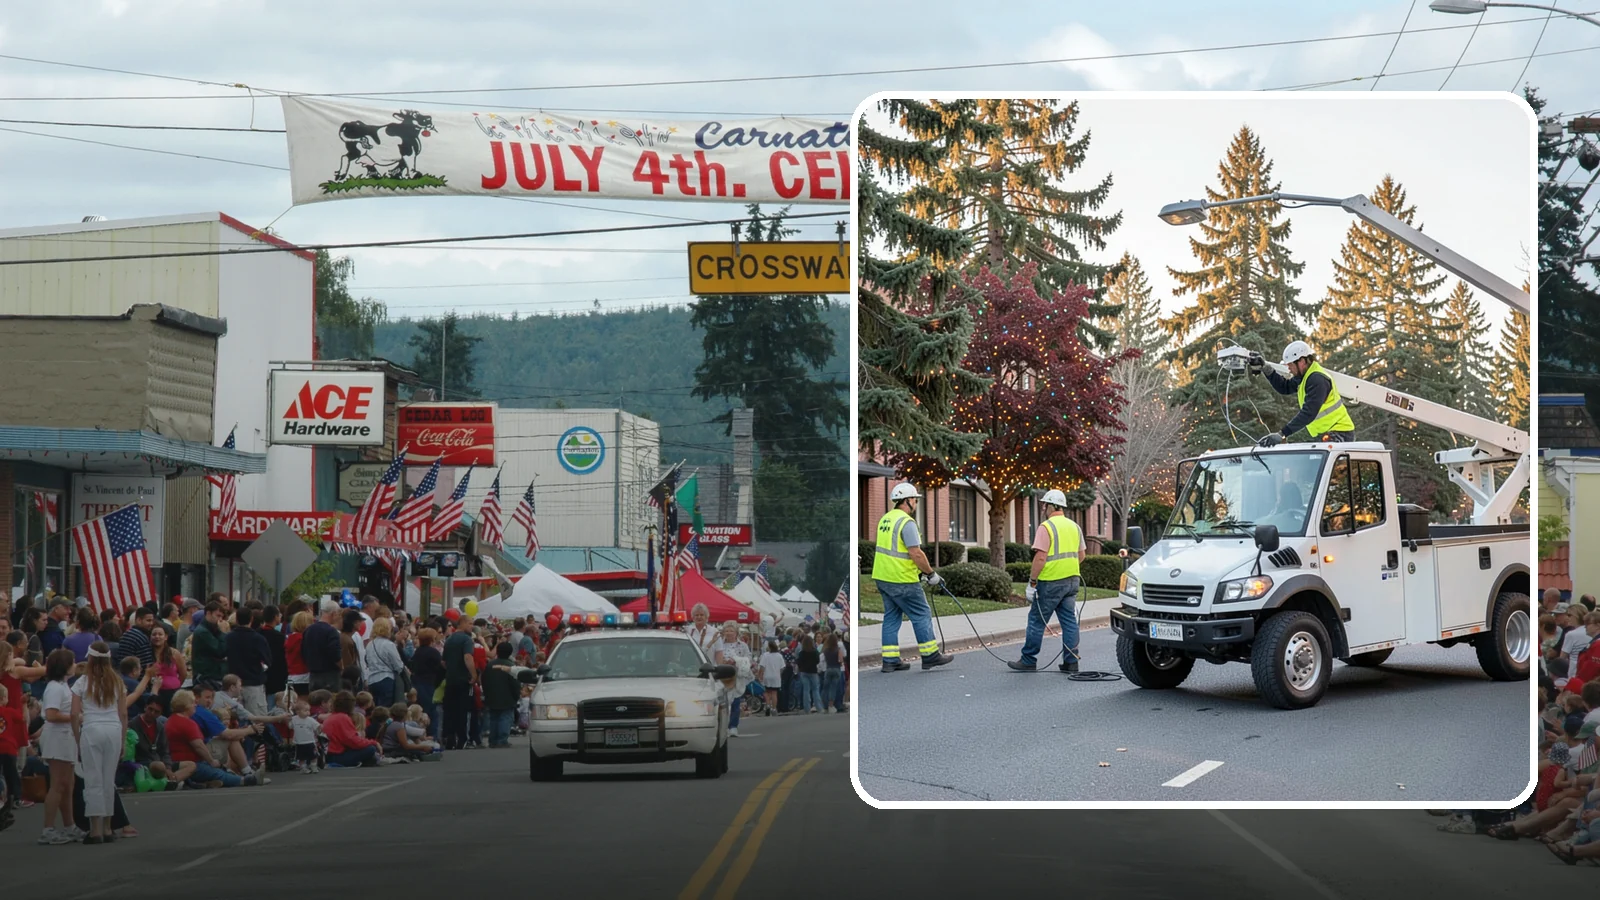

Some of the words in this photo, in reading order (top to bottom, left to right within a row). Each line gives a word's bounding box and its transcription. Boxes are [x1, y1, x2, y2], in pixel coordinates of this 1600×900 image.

[481, 140, 605, 192] JULY
[632, 150, 747, 198] 4th.
[697, 254, 850, 280] CROSSWA
[282, 380, 373, 420] ACE
[405, 409, 453, 422] CEDAR
[283, 421, 371, 436] Hardware
[416, 428, 477, 447] Coca-Cola
[353, 467, 383, 479] Simpl
[95, 485, 124, 495] Vincent
[126, 486, 135, 495] de
[137, 486, 155, 495] Paul
[81, 503, 154, 522] THRT
[688, 526, 741, 536] CRNATION
[699, 535, 730, 544] GLASS
